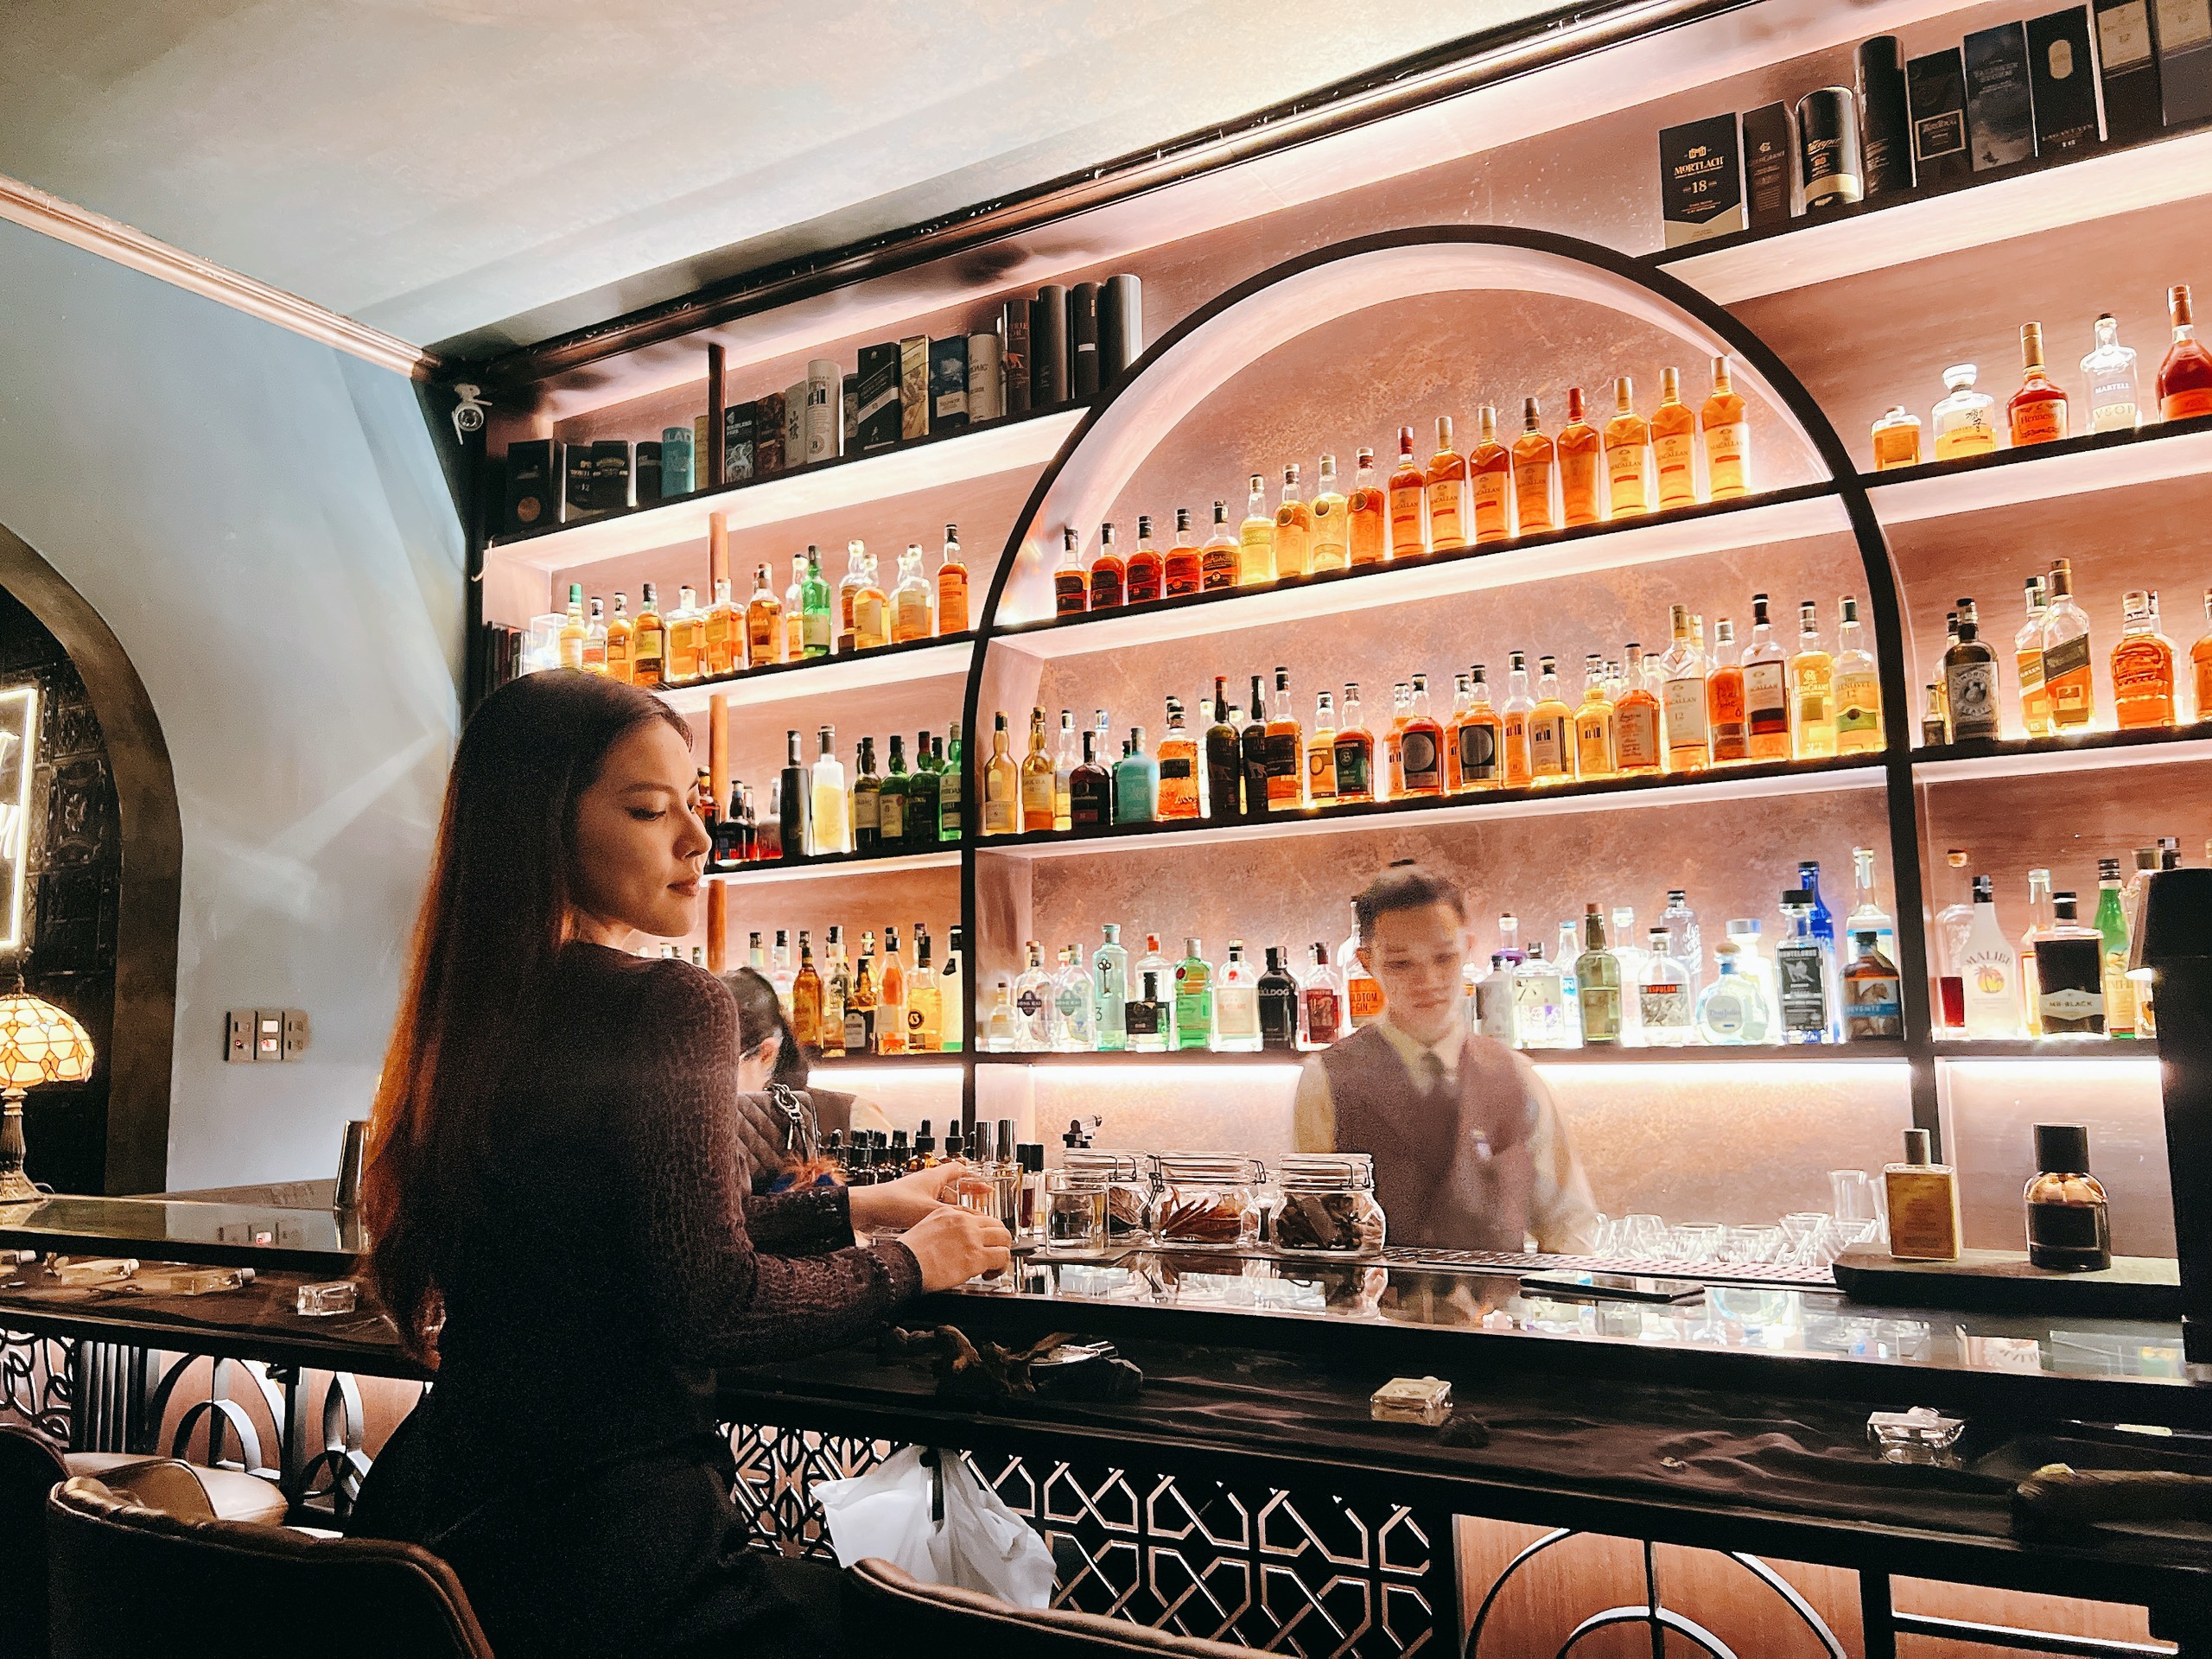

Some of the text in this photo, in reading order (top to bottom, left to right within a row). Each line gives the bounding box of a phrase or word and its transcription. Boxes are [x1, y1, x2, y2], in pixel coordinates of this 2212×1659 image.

[1674, 156, 1725, 176] MORTLACH
[1692, 180, 1707, 194] 18
[2094, 382, 2131, 394] MARTELL
[2094, 404, 2134, 419] VSOP
[1665, 696, 1697, 706] CALLAN
[1675, 711, 1685, 721] 12
[1965, 950, 2012, 968] MALIBU
[1095, 1007, 1103, 1021] 3
[1356, 1002, 1369, 1012] GIN
